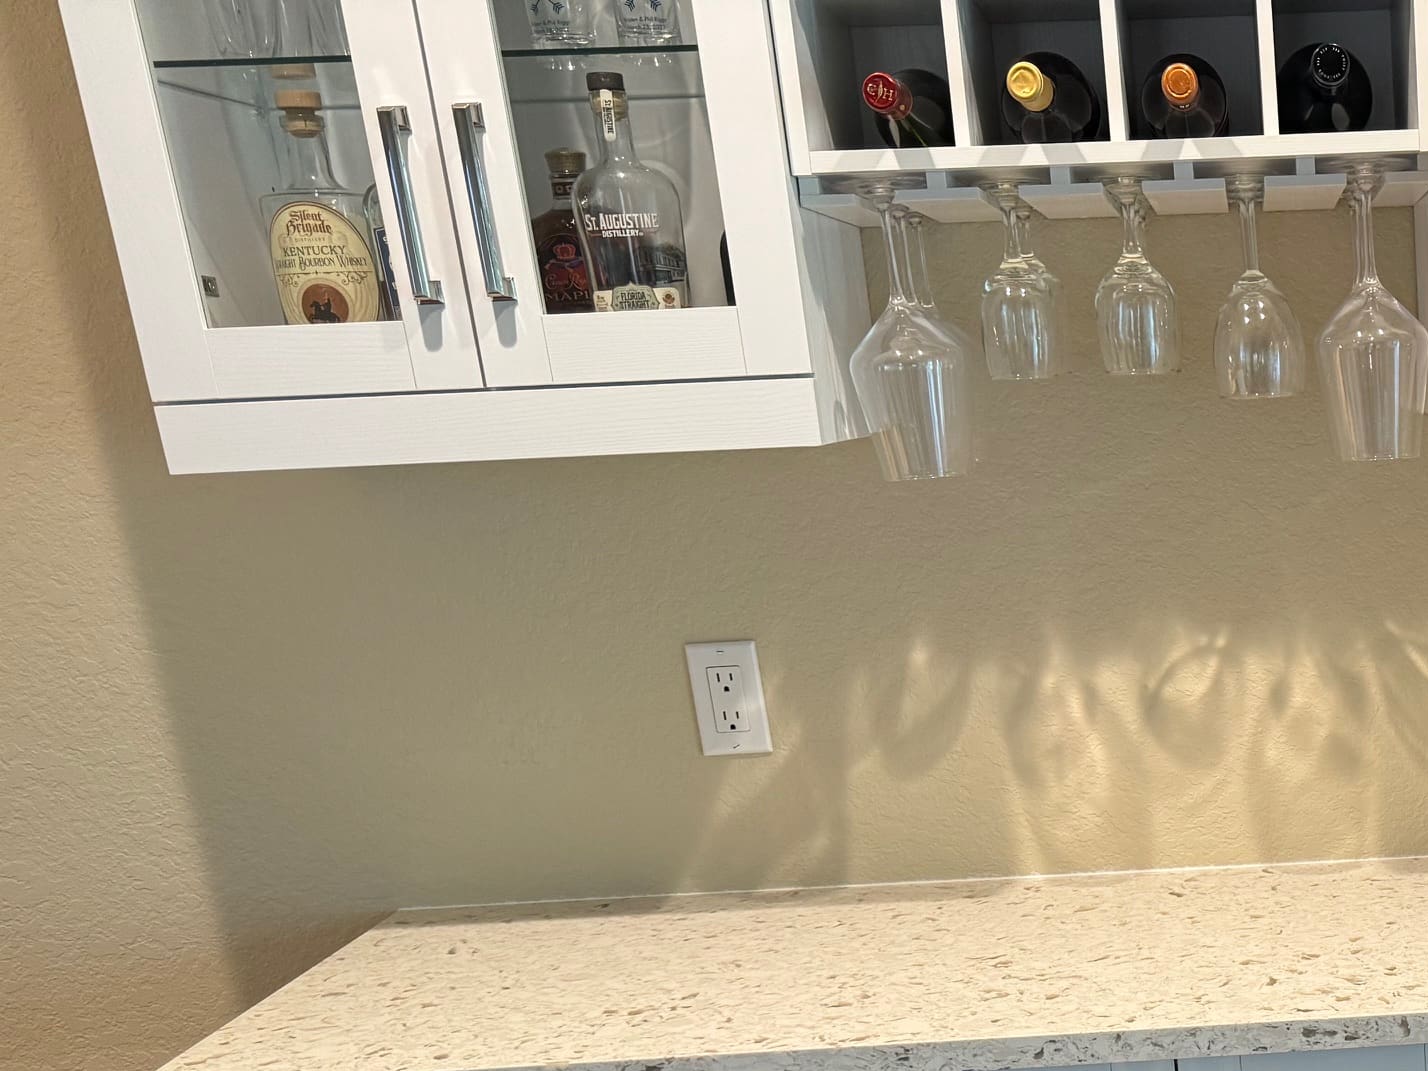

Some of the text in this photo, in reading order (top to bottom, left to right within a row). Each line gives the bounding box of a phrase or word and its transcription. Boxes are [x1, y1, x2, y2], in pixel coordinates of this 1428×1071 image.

[289, 209, 323, 222] Silent
[599, 212, 660, 230] AUGUSTINE
[286, 220, 333, 237] Brigade
[602, 229, 640, 238] DISTILLERY
[283, 245, 346, 257] KENTUCKY
[620, 291, 647, 301] FLORIDA
